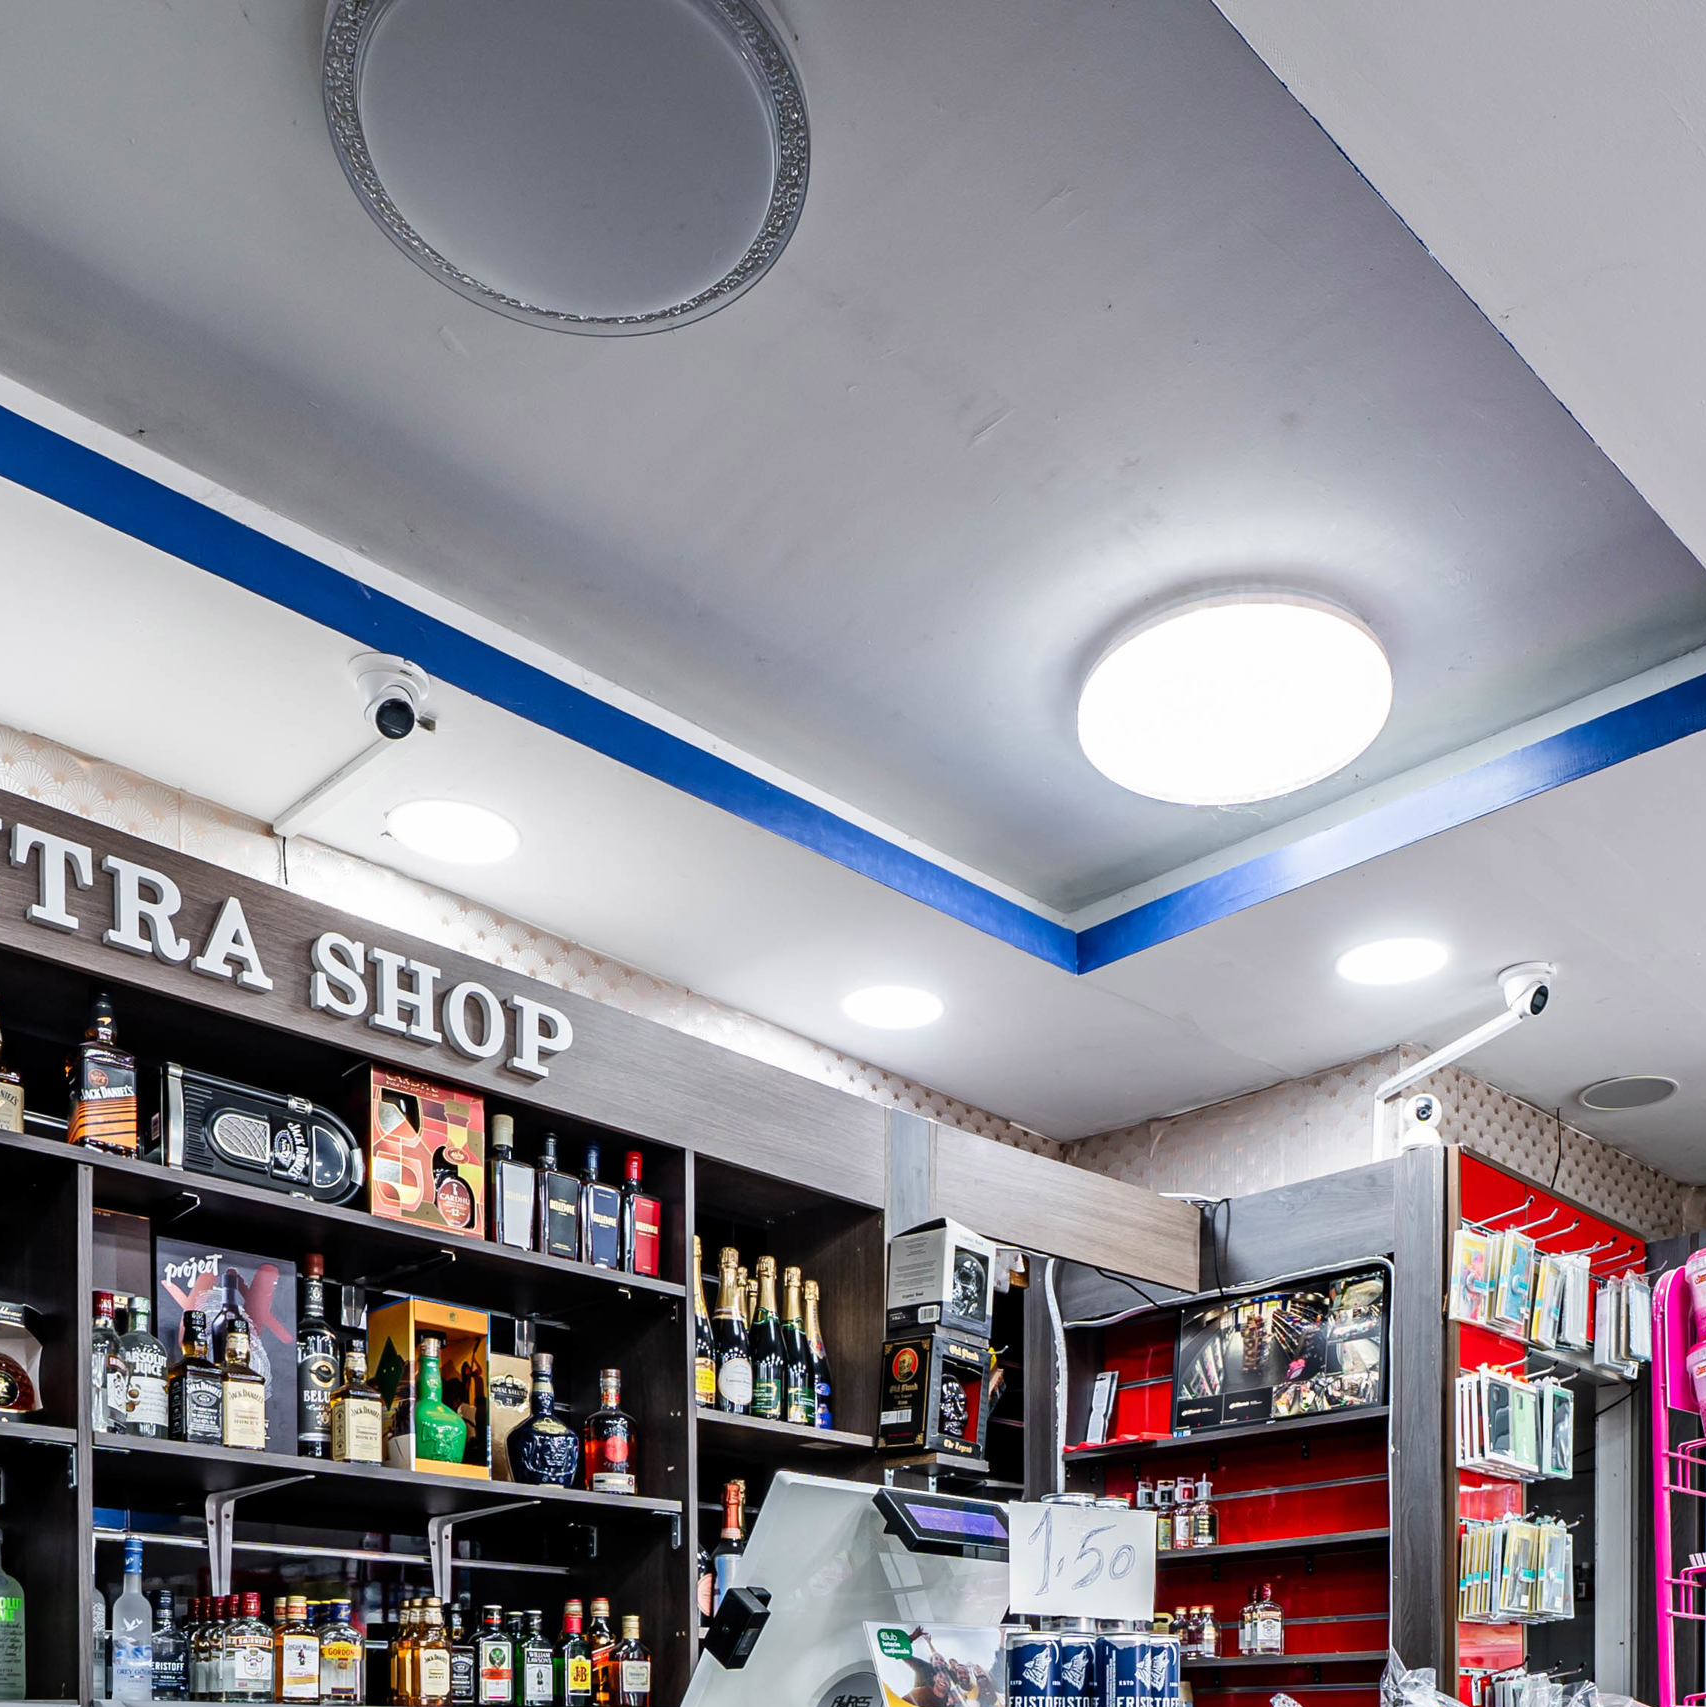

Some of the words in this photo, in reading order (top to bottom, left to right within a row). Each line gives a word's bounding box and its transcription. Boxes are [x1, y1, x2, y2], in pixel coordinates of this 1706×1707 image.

[309, 930, 574, 1079] SHOP
[80, 1088, 101, 1101] JACK
[101, 1084, 134, 1098] DANIEL'S
[287, 1122, 306, 1149] JACK
[439, 1192, 471, 1205] CARDHU
[163, 1254, 223, 1289] project
[125, 1350, 168, 1369] ABSOLUT
[133, 1360, 163, 1376] JUICE
[236, 1636, 272, 1648] SMIRNOFF
[527, 1650, 552, 1658] WILLIAM
